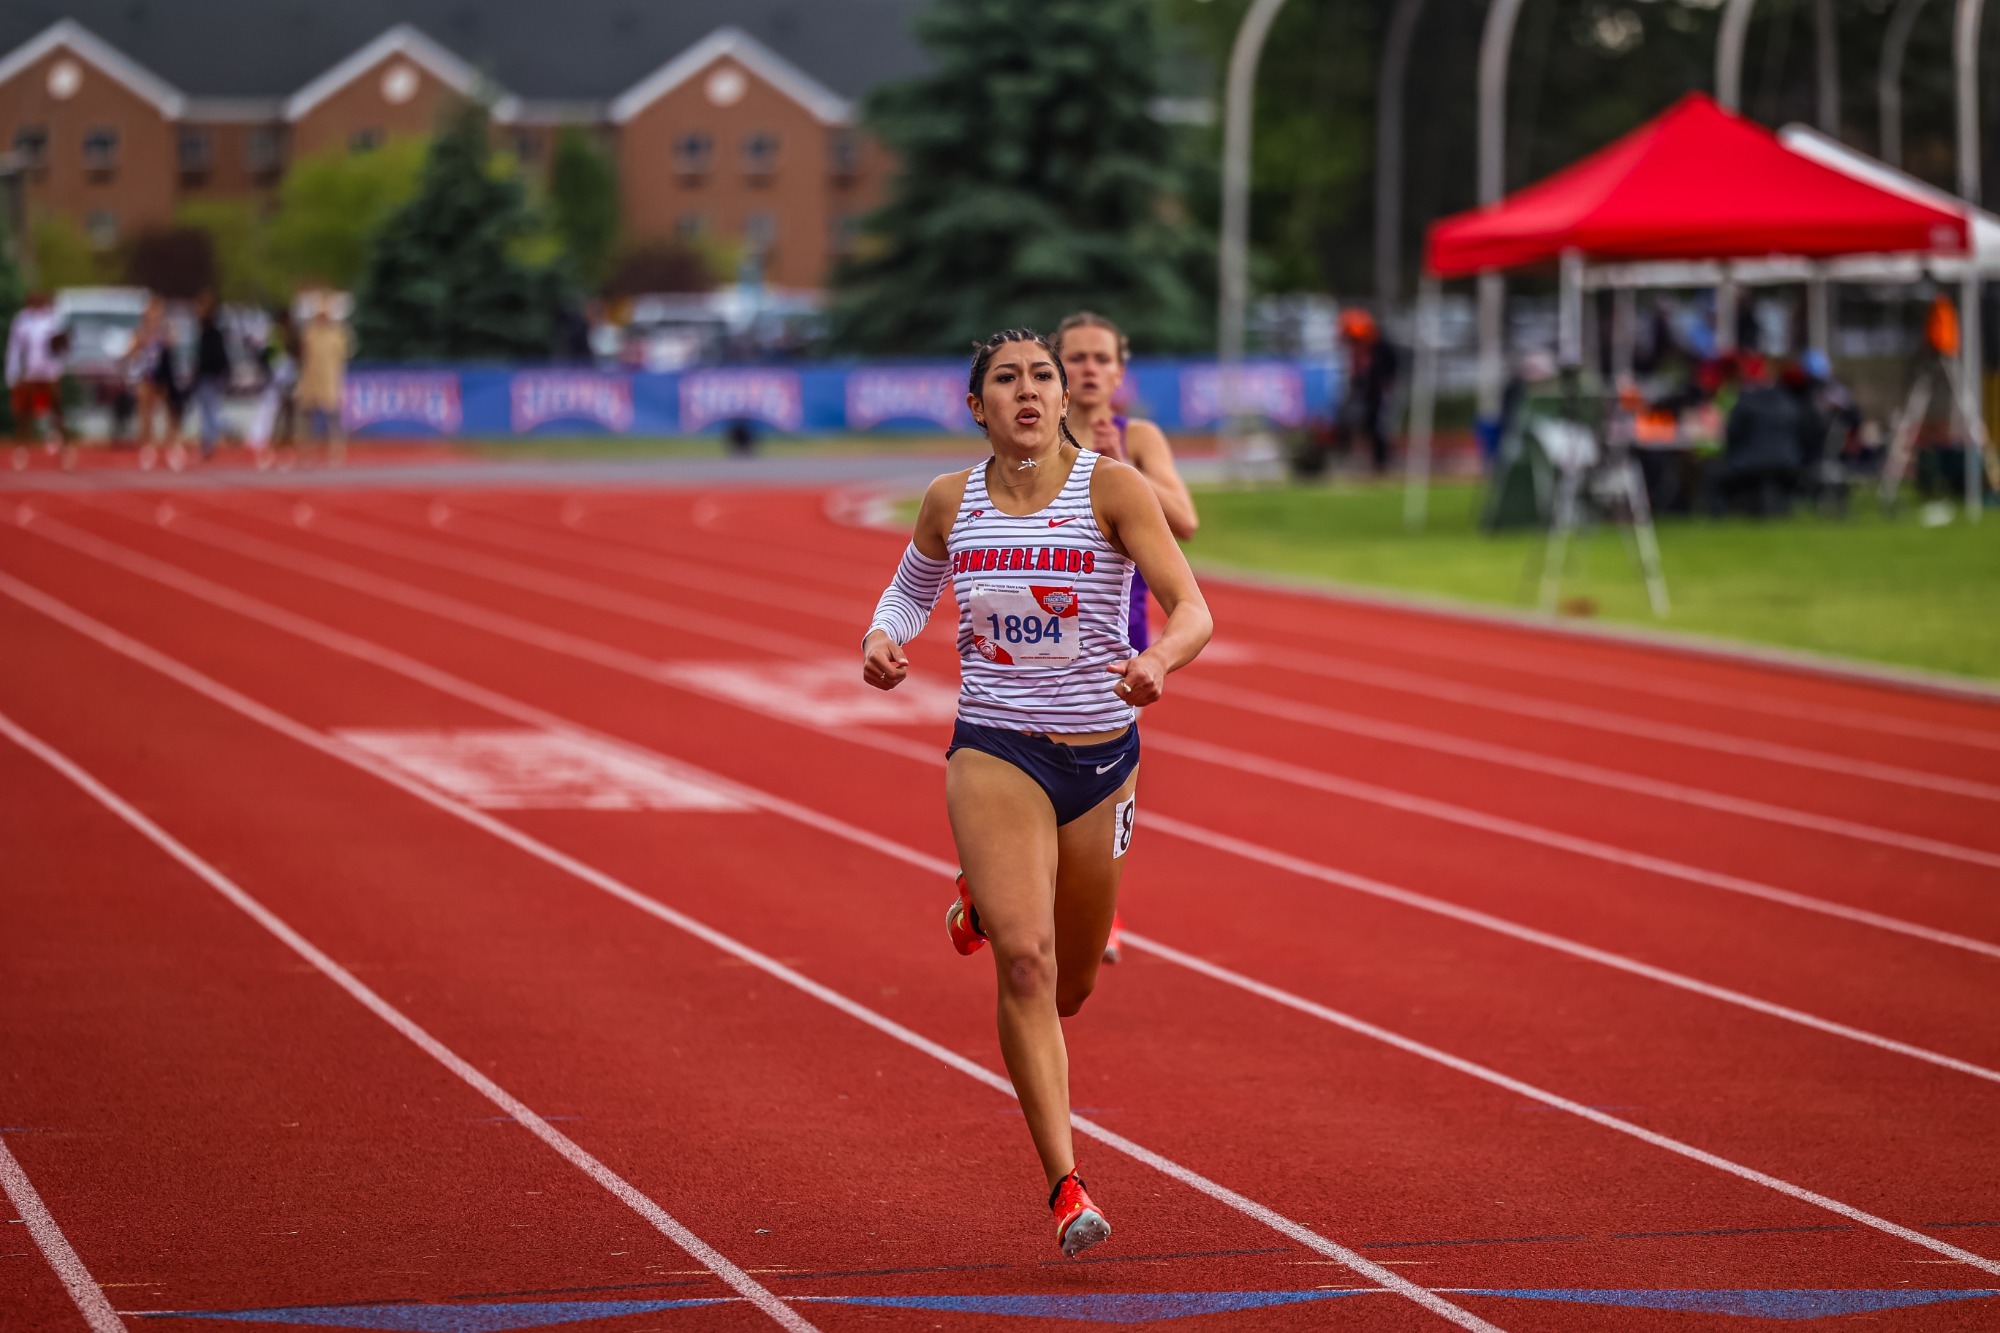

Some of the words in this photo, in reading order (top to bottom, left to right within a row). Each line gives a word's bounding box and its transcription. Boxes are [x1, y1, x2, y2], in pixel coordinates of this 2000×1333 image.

[954, 548, 1095, 575] CUMBERLANDS
[987, 614, 1062, 644] 1894
[1121, 801, 1133, 850] 8
